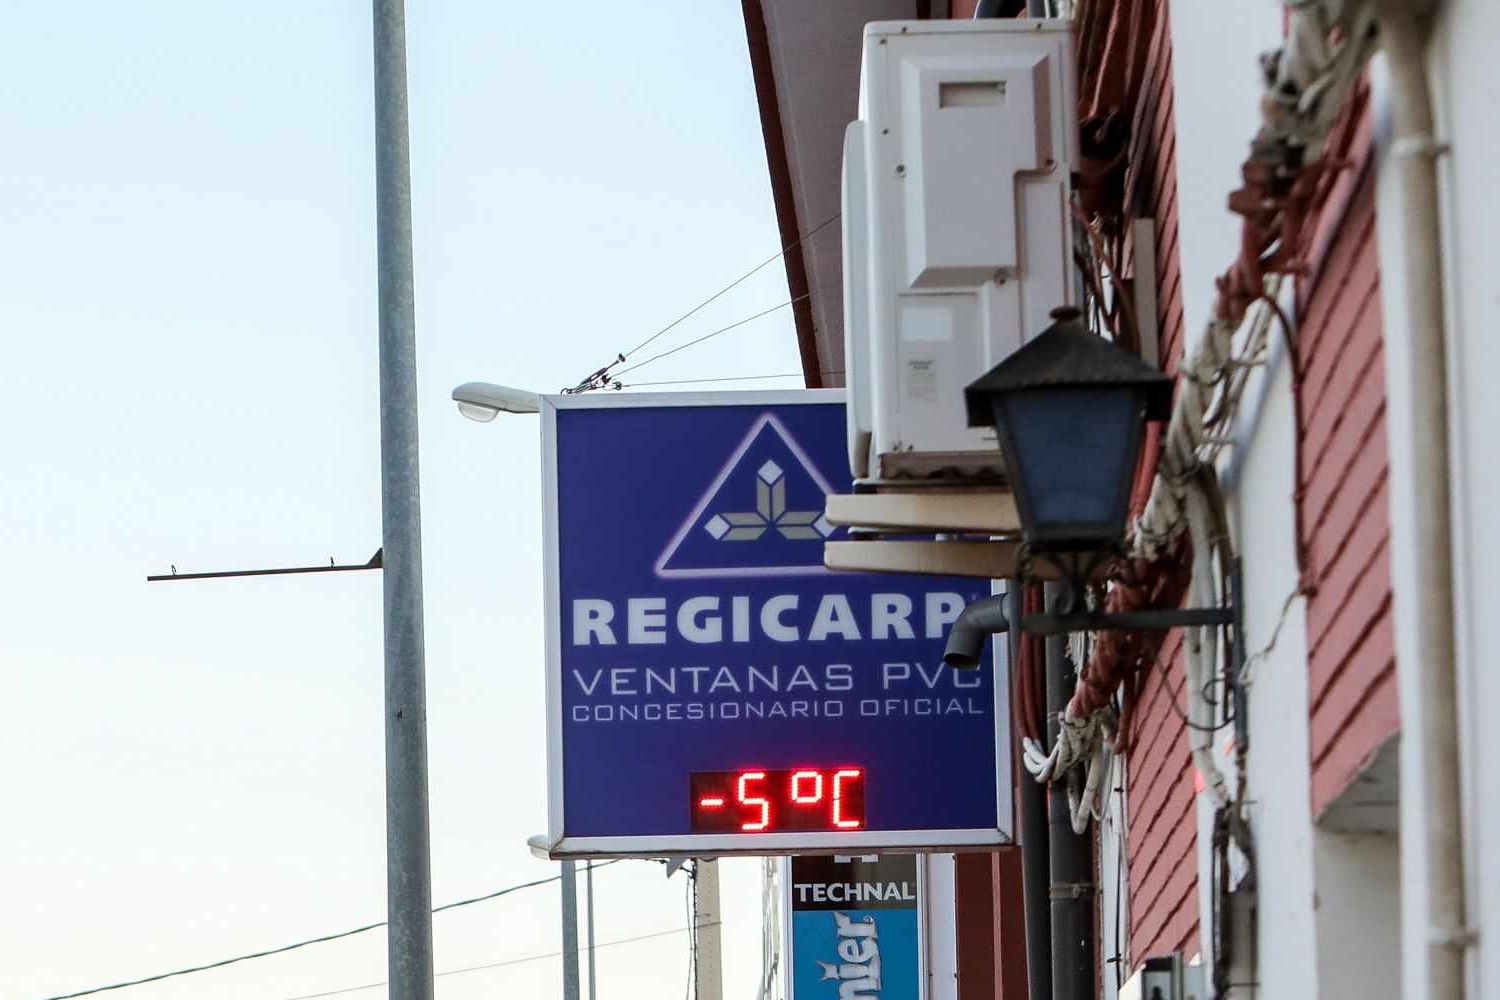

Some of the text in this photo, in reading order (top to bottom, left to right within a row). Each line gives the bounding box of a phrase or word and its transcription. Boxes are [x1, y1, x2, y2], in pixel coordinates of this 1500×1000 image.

[573, 592, 966, 646] REGICARP
[573, 662, 981, 695] VENTANAS PVC
[573, 697, 984, 722] CONCESIONARIO OFICIAL
[793, 881, 917, 902] TECHNAL
